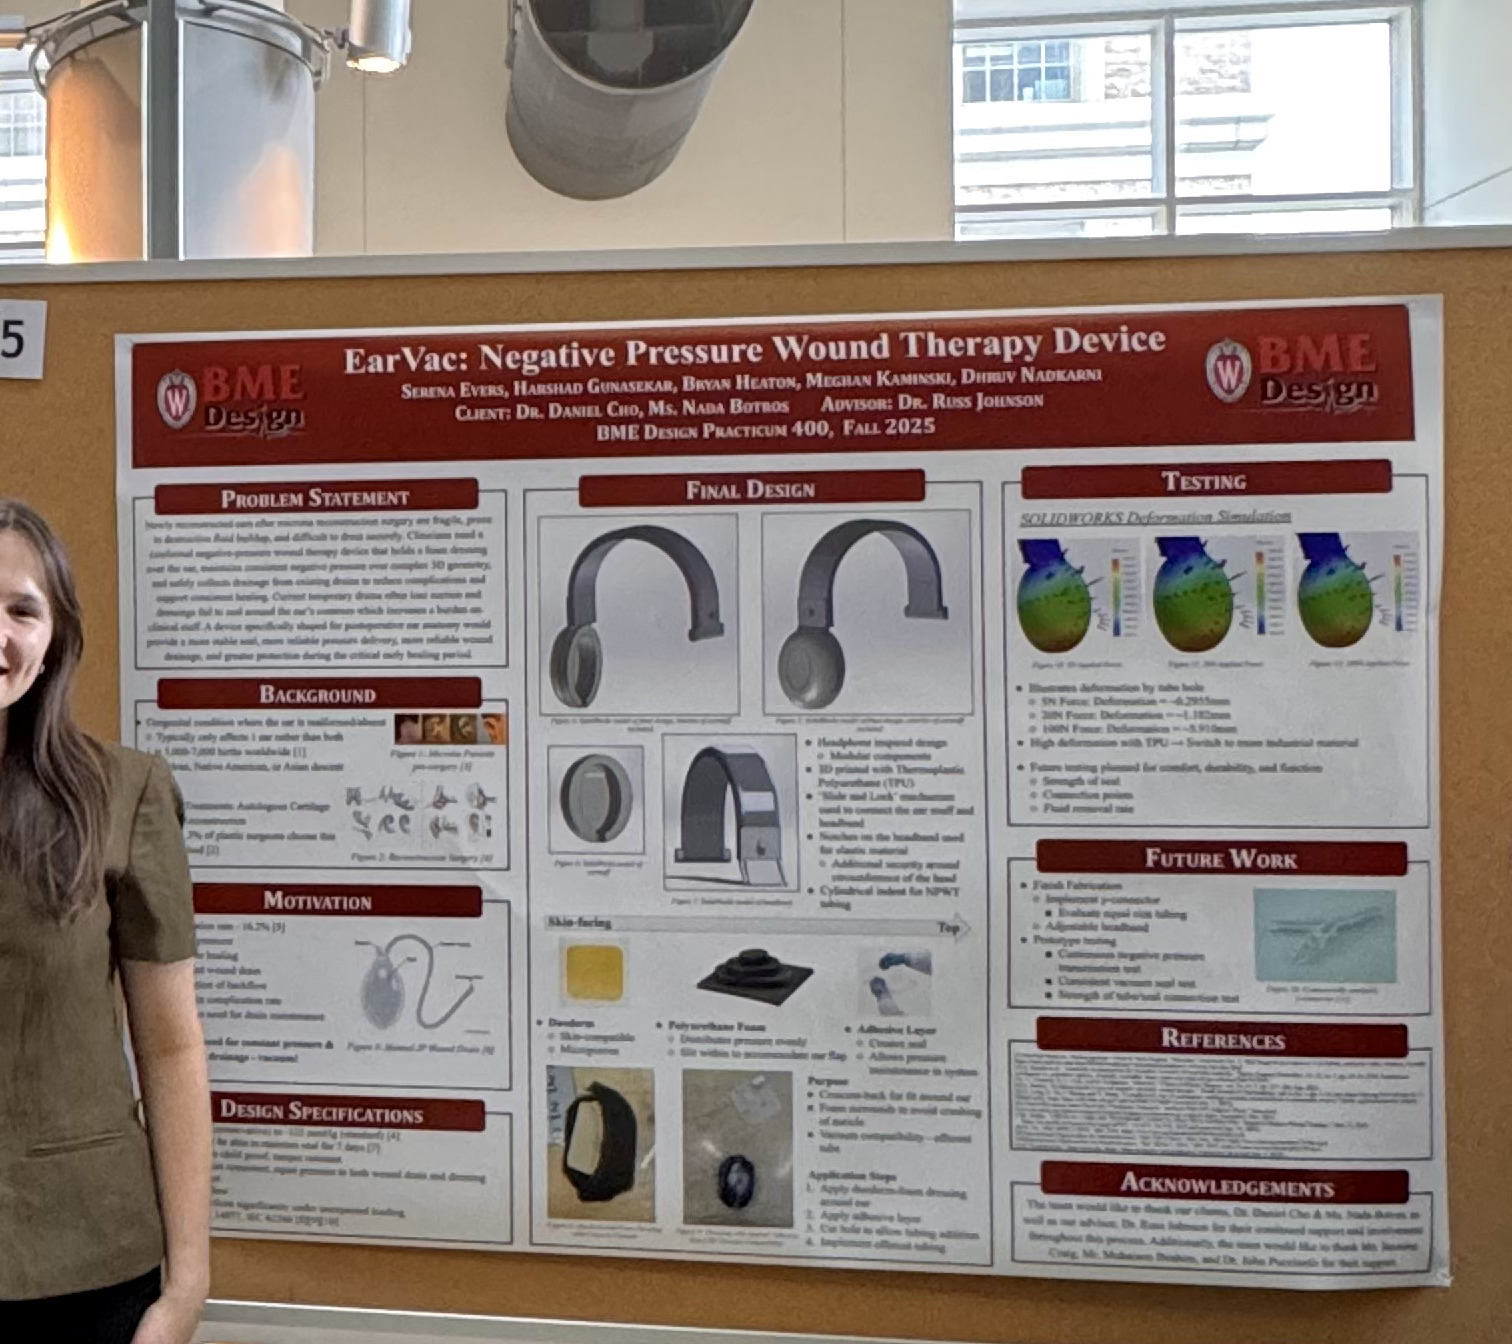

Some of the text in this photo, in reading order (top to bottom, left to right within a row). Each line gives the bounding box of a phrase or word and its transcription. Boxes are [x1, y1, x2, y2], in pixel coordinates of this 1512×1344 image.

[344, 325, 1166, 376] EarVac: Negative Pressure Wound Therapy Device
[1257, 333, 1376, 373] BME
[201, 364, 306, 402] BME
[1259, 376, 1378, 415] Design
[205, 404, 306, 440] Design
[597, 425, 640, 441] BME
[791, 421, 834, 438] 400,
[885, 418, 936, 435] 2025
